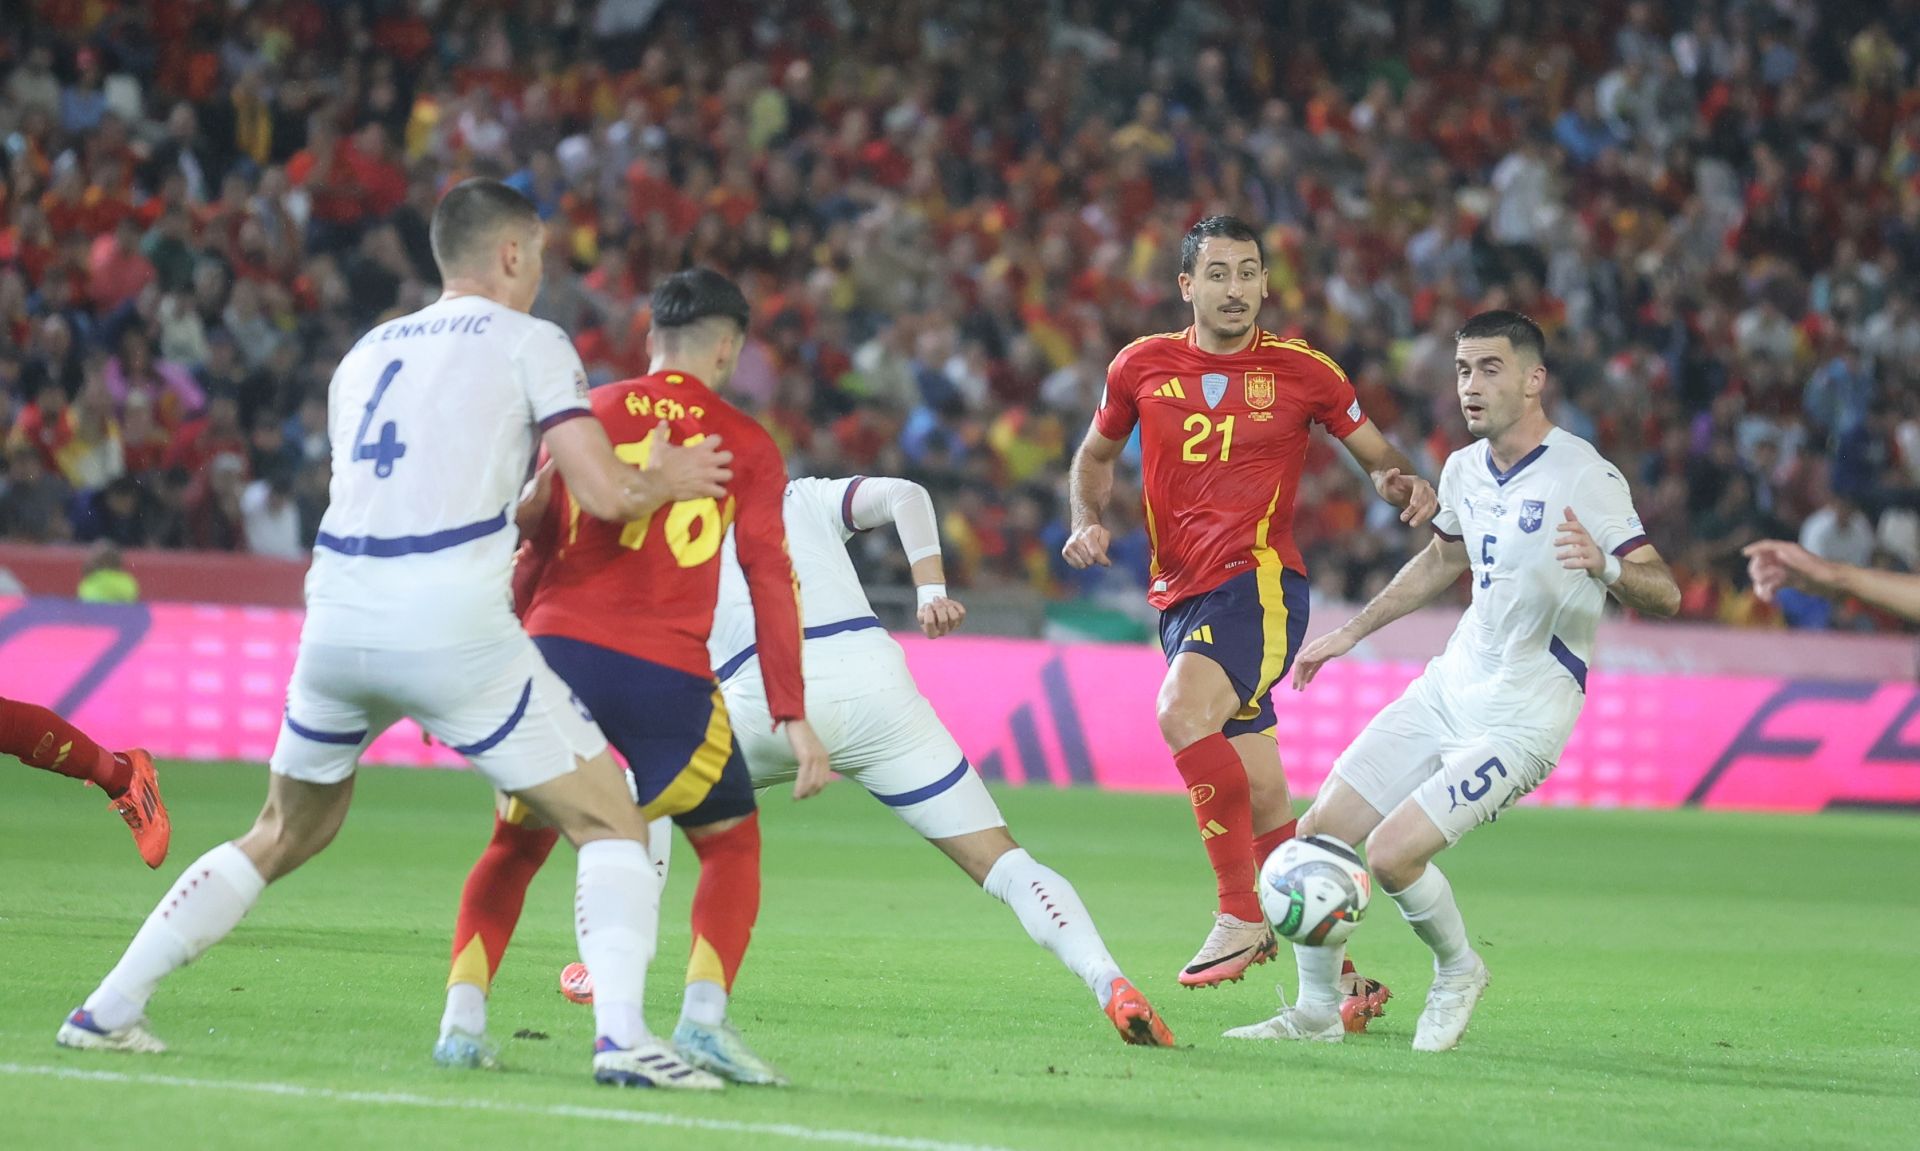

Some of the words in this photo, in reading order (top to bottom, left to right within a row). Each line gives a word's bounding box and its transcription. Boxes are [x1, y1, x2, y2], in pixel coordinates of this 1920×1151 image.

[352, 359, 406, 478] 4
[1183, 412, 1235, 462] 21
[1481, 534, 1497, 589] 5
[1460, 756, 1507, 801] 5
